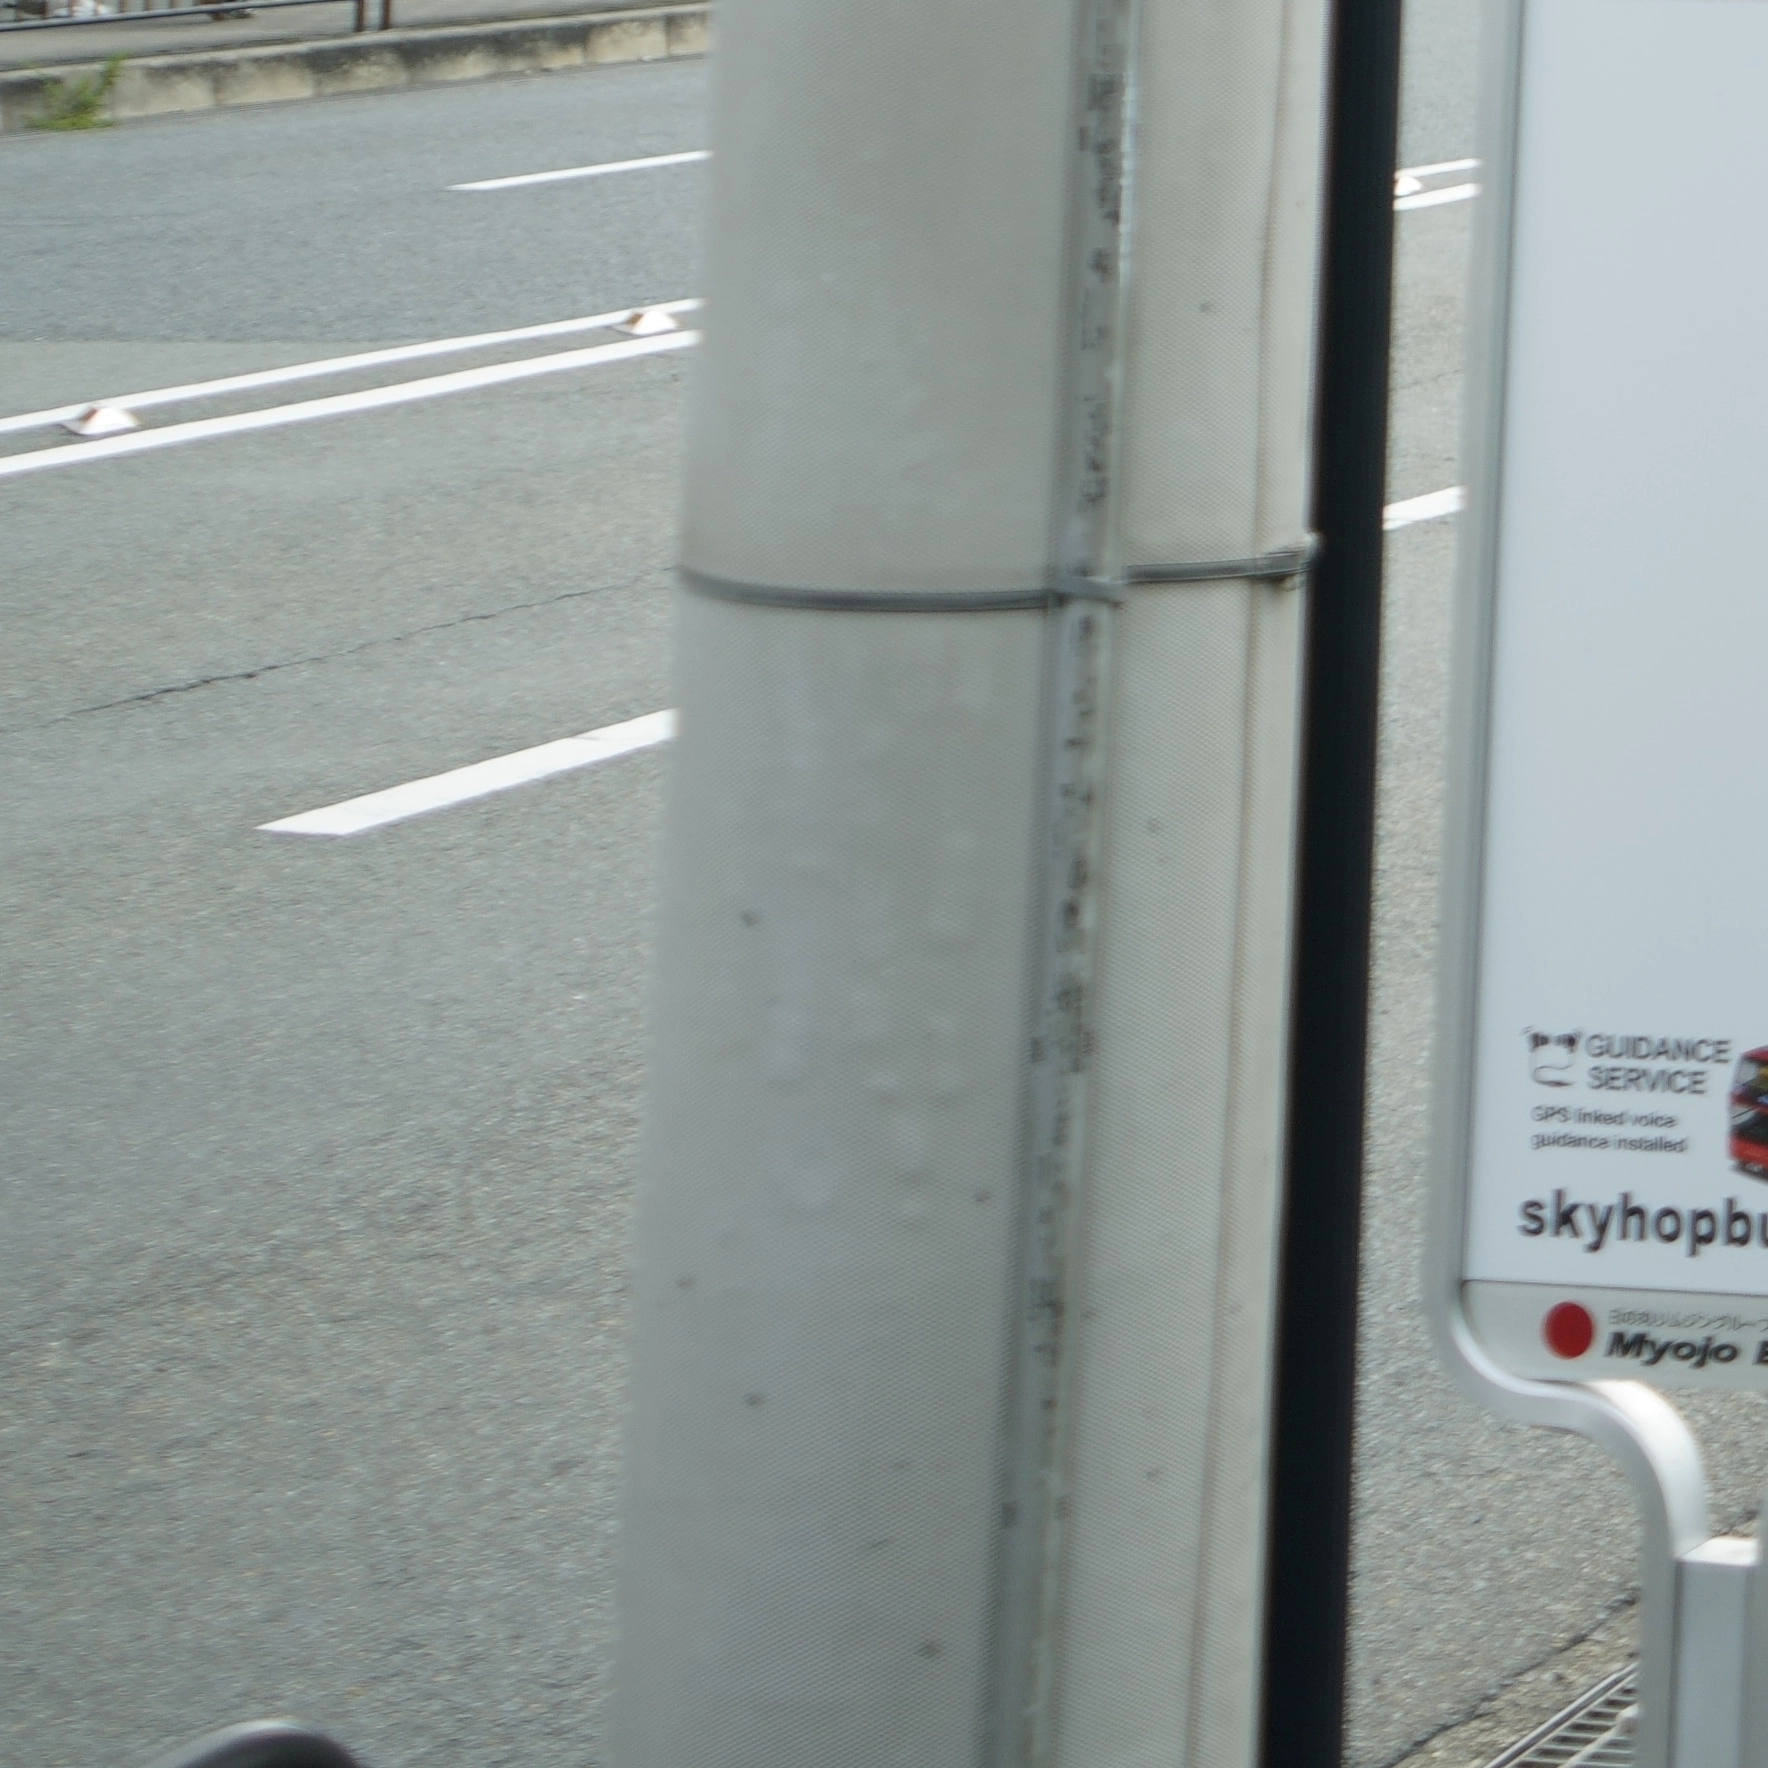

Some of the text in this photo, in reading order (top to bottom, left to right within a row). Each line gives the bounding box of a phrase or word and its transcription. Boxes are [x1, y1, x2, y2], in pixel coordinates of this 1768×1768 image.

[1585, 1034, 1732, 1063] GUIDANCE
[1587, 1065, 1708, 1095] SERVICE
[1530, 1105, 1679, 1128] GPS linked voice
[1529, 1132, 1688, 1153] guidance installed
[1604, 1331, 1740, 1369] Myojo
